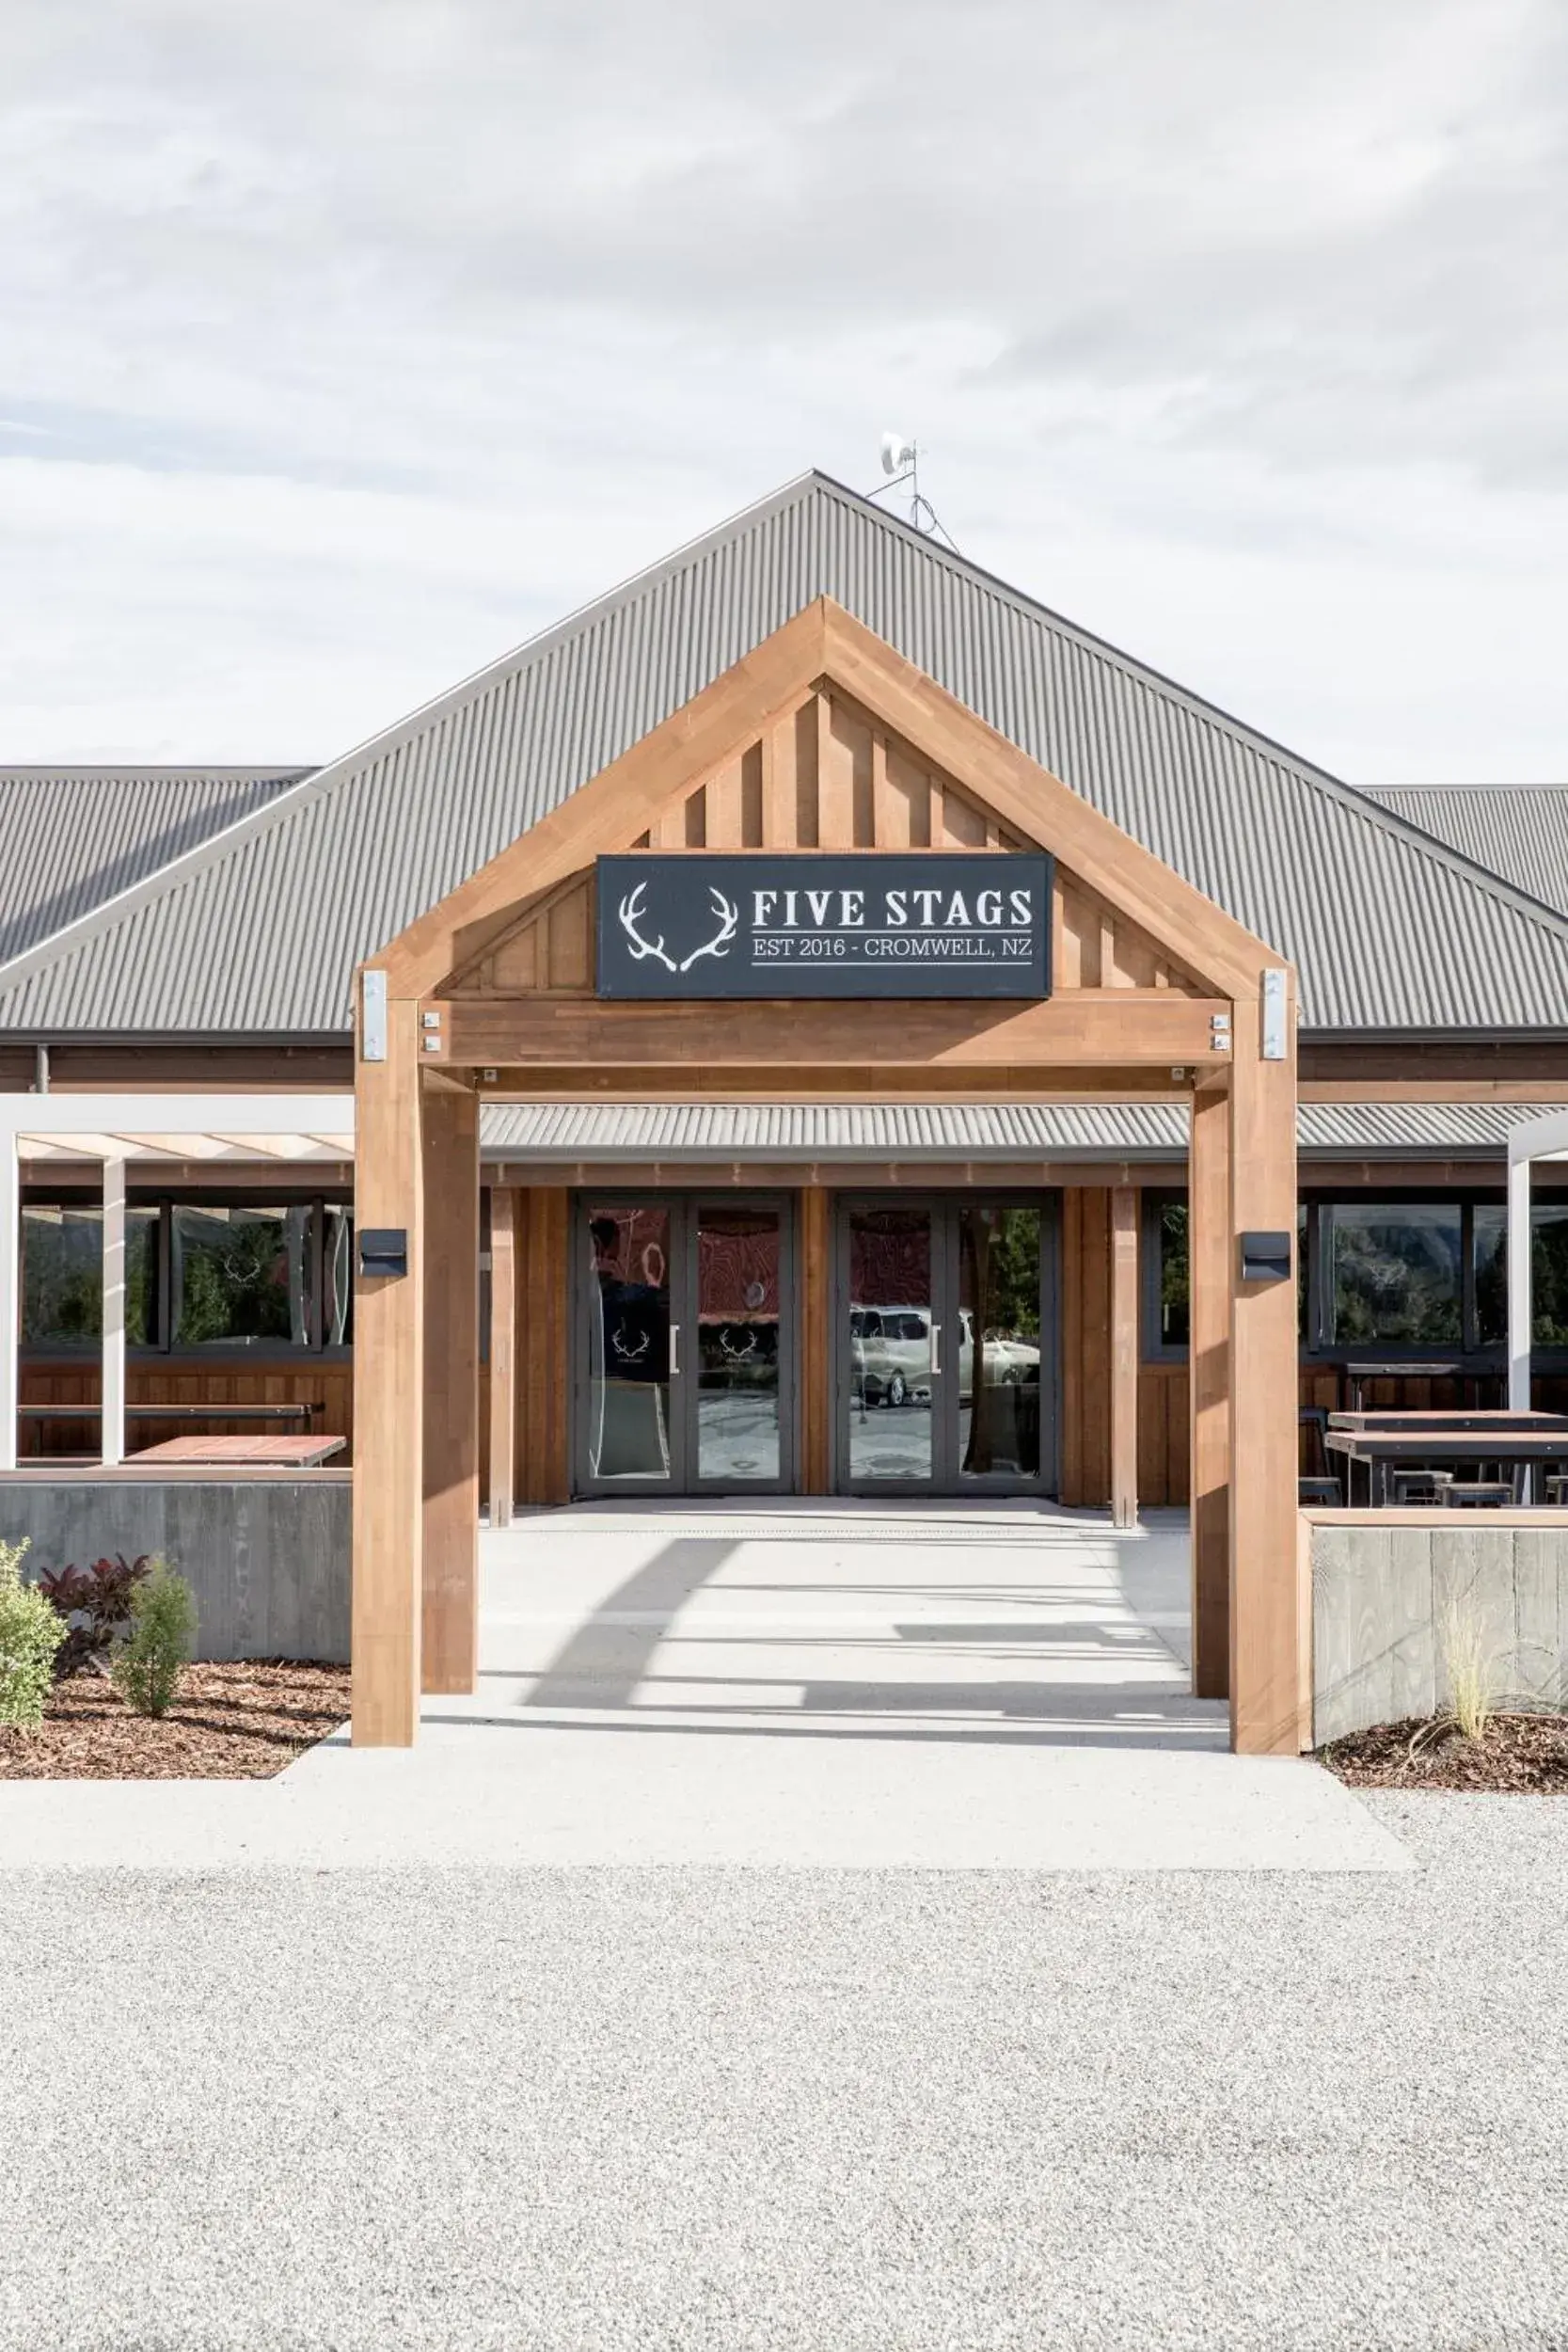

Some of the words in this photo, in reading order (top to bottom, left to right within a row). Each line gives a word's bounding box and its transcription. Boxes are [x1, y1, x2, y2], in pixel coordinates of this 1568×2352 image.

[752, 889, 865, 927] FIVE
[885, 889, 1033, 927] STAGS
[752, 938, 795, 957] EST
[799, 938, 847, 957] 2016
[863, 938, 995, 958] CROMWELL,
[1002, 938, 1033, 957] NZ
